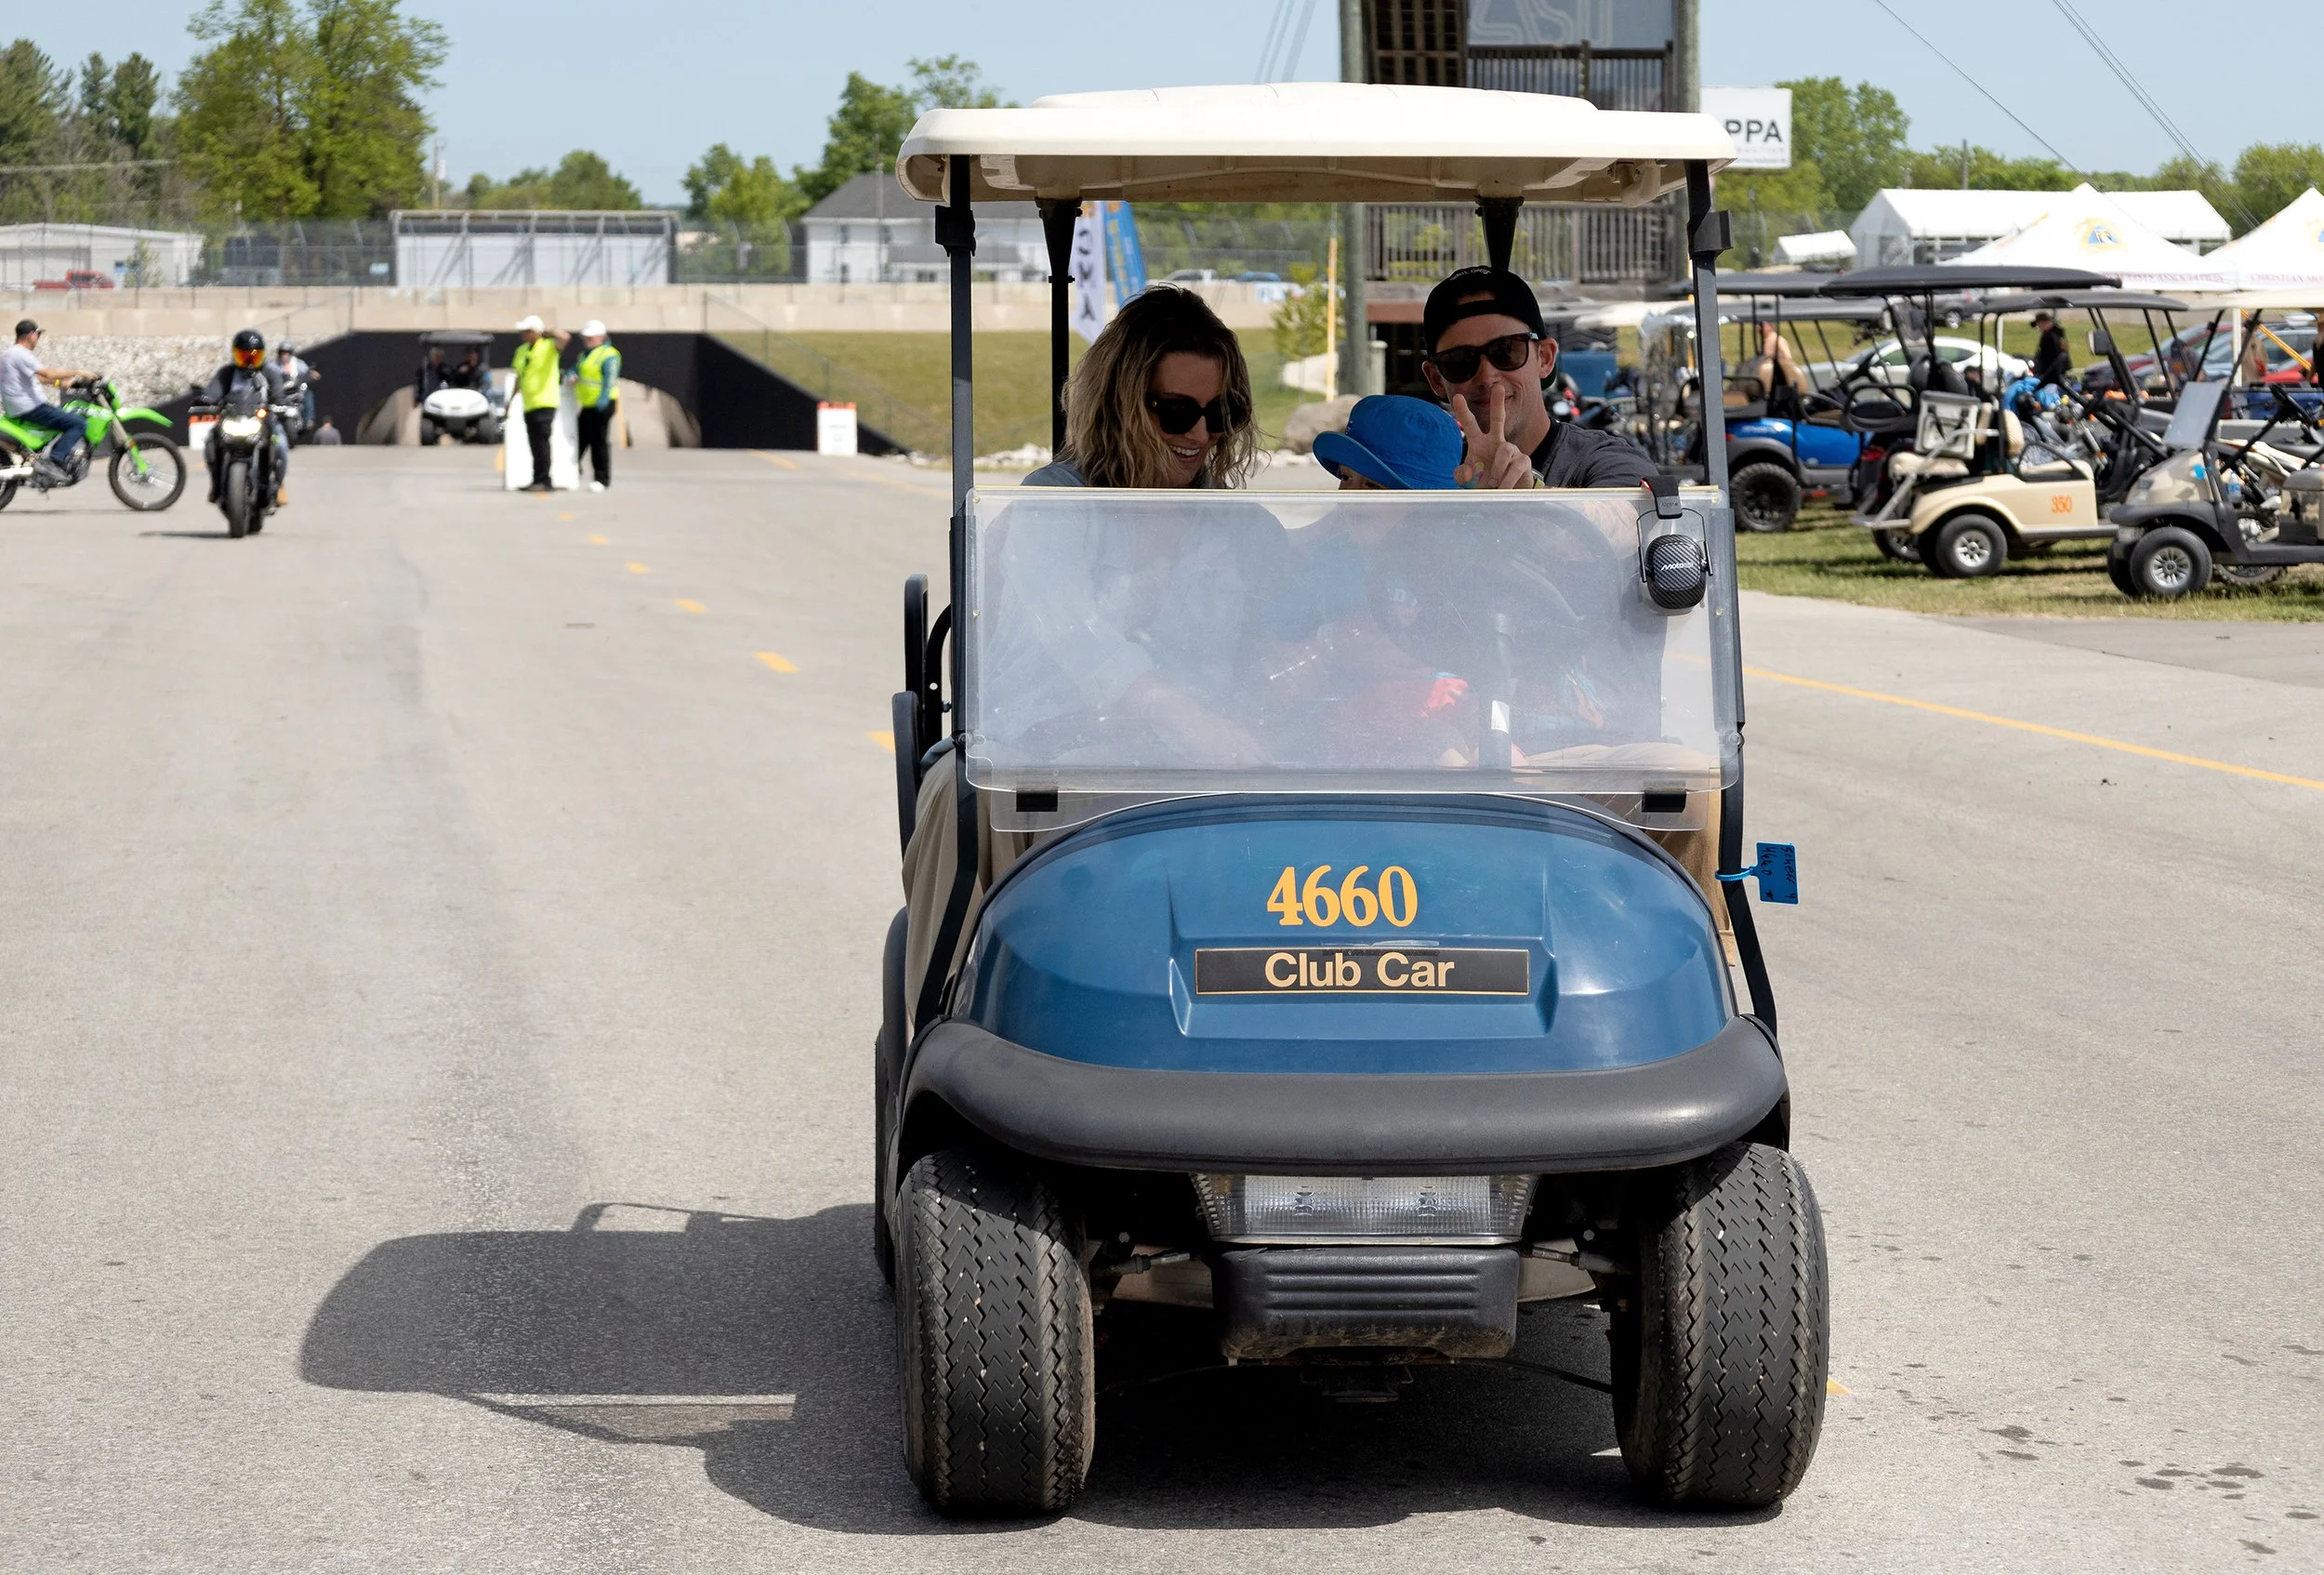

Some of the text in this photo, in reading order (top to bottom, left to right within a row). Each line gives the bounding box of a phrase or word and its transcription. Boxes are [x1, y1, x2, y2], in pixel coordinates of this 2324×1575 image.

[2052, 495, 2073, 514] 350
[1267, 865, 1419, 927] 4660
[1264, 952, 1455, 987] Club Car
